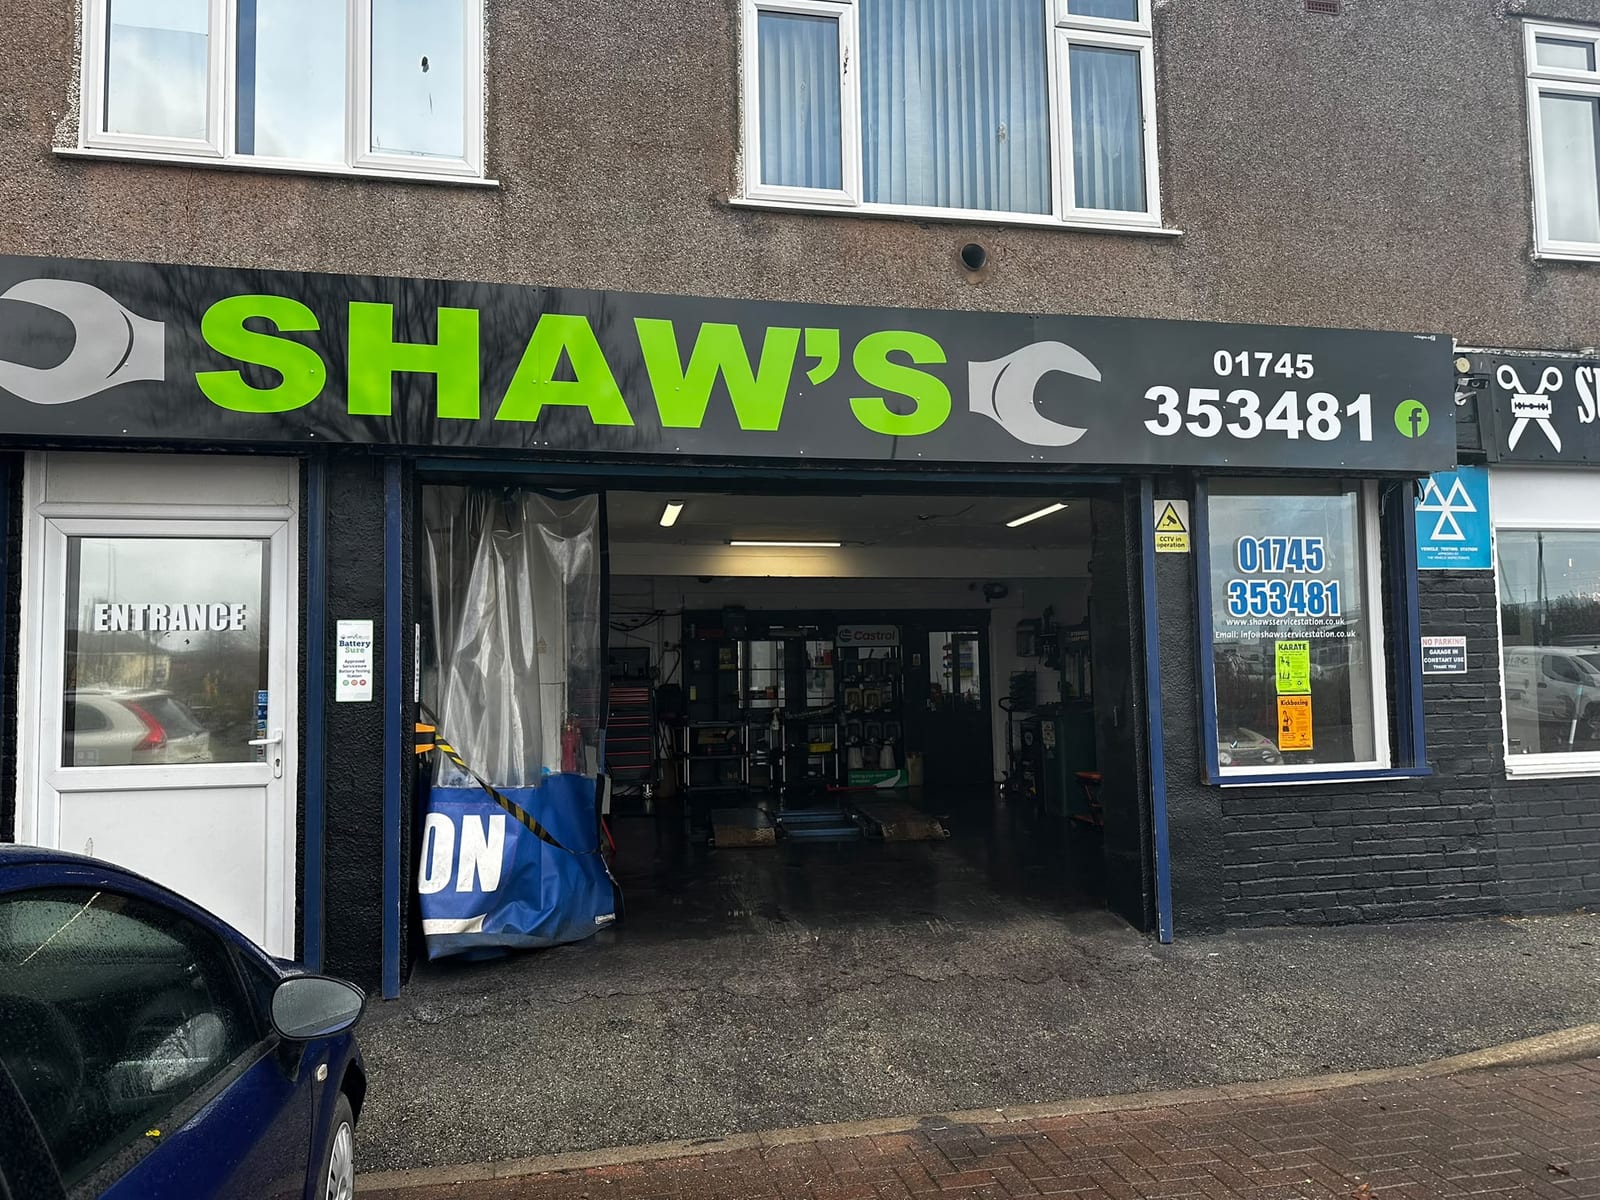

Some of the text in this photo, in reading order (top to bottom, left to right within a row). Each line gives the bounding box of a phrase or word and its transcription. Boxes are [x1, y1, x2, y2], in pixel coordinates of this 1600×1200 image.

[1213, 350, 1315, 379] 01745
[1143, 385, 1374, 443] 353481
[1237, 535, 1325, 574] 01745
[1228, 579, 1341, 617] 353481
[94, 602, 247, 632] ENTRANCE
[1226, 617, 1345, 626] www.shawsservicestation.co.uk
[854, 630, 896, 641] Castrol
[1215, 630, 1356, 640] Email: info@shawsservicestation.co.uk
[339, 640, 371, 648] Battery
[1278, 643, 1307, 651] KARATE
[1422, 638, 1465, 646] NO PARKING
[1280, 699, 1309, 707] Kickboxing
